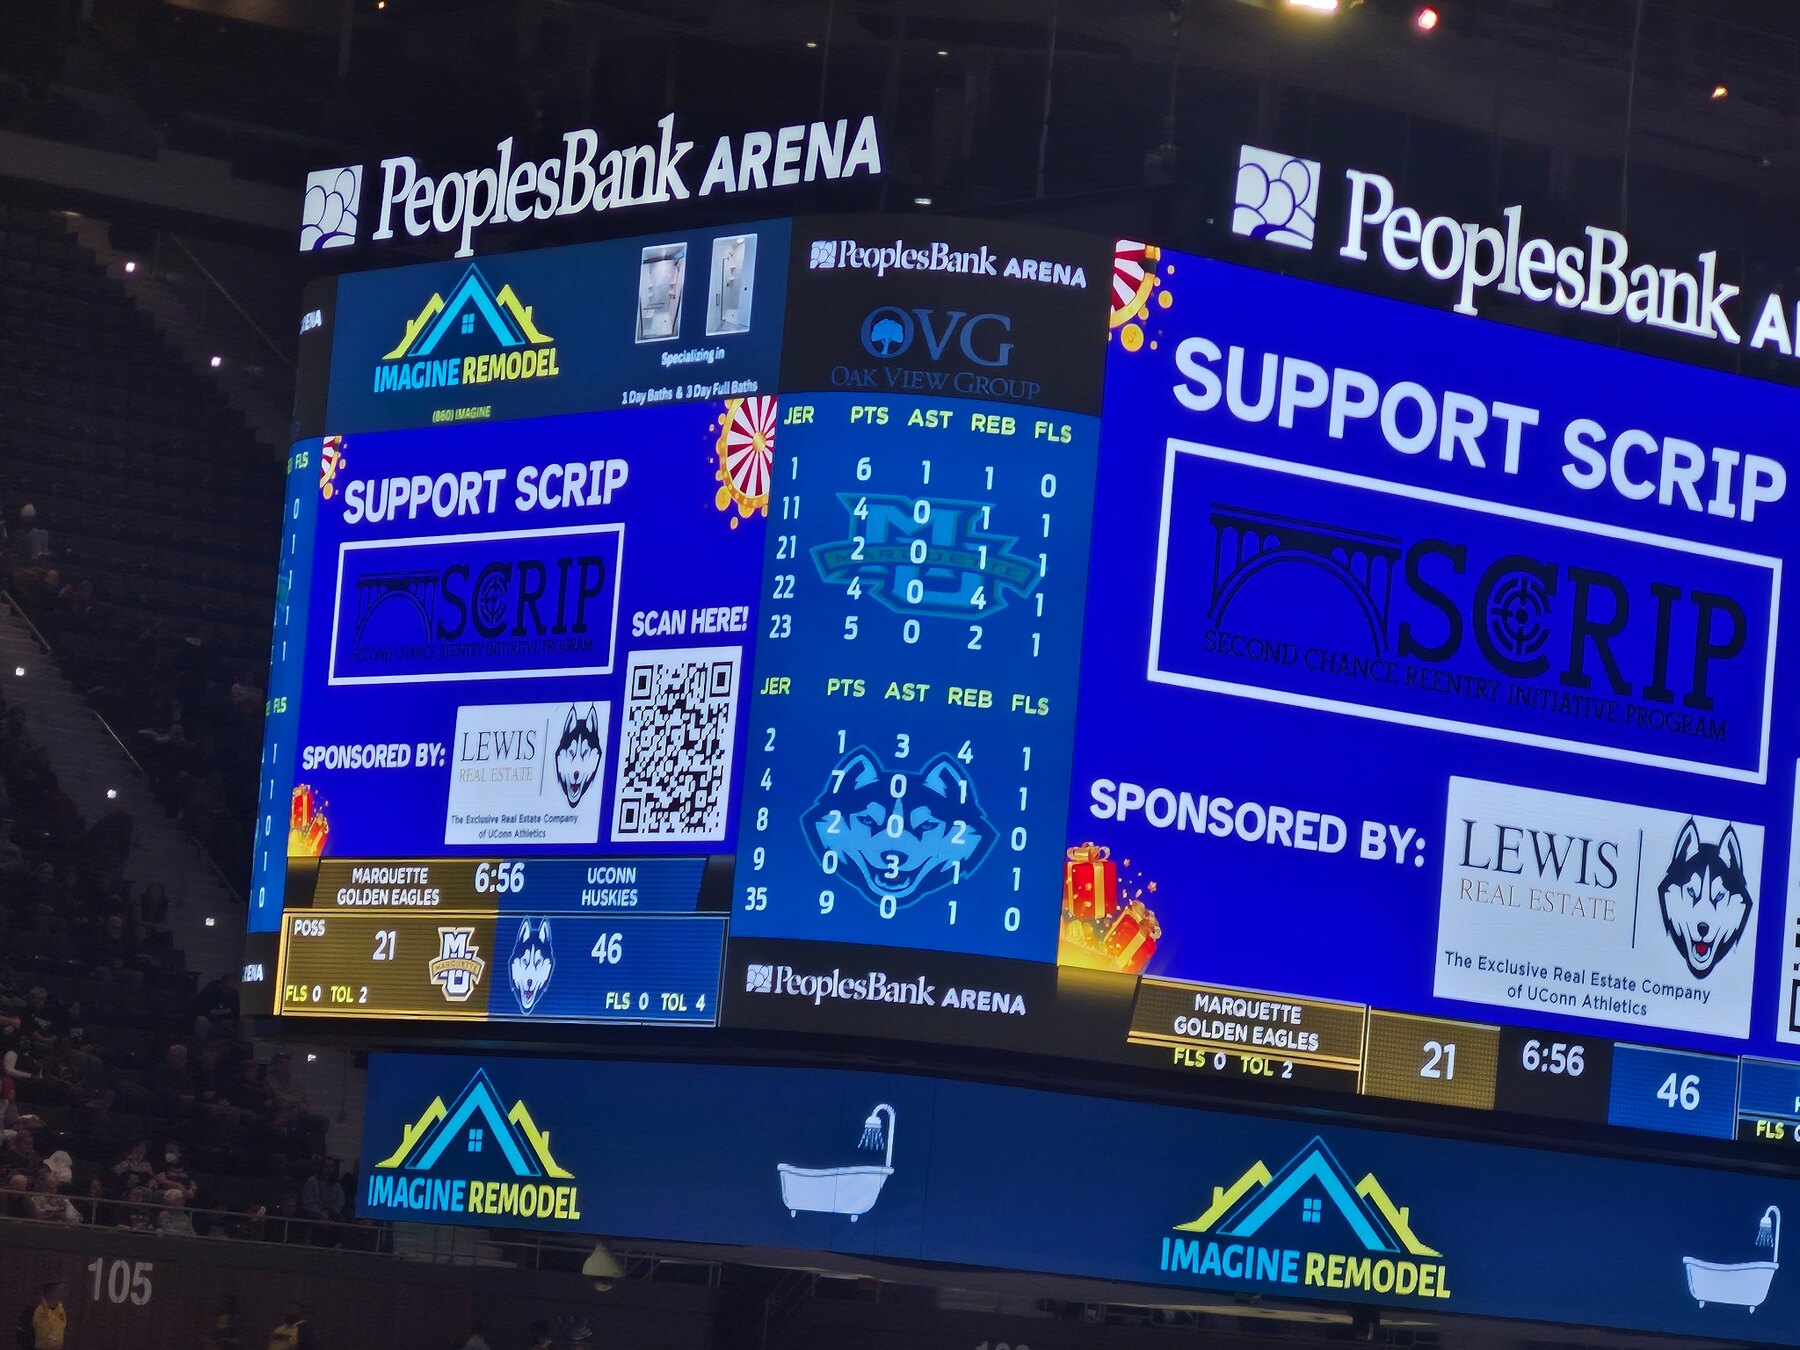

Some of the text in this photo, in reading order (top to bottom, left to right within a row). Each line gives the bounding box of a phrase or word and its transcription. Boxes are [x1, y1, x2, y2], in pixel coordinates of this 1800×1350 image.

[372, 112, 881, 258] PeoplesBank ARENA
[838, 240, 1086, 288] PeoplesBank ARENA
[1340, 169, 1740, 344] PeoplesBank
[861, 306, 1014, 367] OVG
[374, 348, 559, 392] IMAGINE REMODEL
[662, 347, 725, 367] Specializing in
[629, 391, 647, 406] Day
[647, 387, 673, 402] Baths
[676, 386, 683, 399] &
[686, 385, 693, 398] 3
[694, 384, 712, 400] Day
[713, 381, 730, 396] Full
[731, 379, 758, 394] Baths
[831, 366, 1041, 400] OAK VIEW GROUP
[432, 406, 491, 423] (860) IMAGINE
[784, 406, 1071, 443] JER PTS AST REB FLS
[1173, 335, 1786, 522] SUPPORT SCRIP
[343, 459, 628, 524] SUPPORT SCRIP
[792, 457, 1056, 498] 1 6 1 1 0
[783, 496, 1049, 537] 11 4 0 1 1
[777, 535, 796, 559] 21
[851, 536, 864, 560] 2
[911, 539, 927, 563] 0
[979, 546, 986, 569] 1
[1039, 554, 1046, 577] 1
[436, 555, 605, 641] SCRIP
[773, 575, 1043, 617] 22 4 0 4 1
[632, 606, 748, 637] SCAN HERE!
[770, 614, 1040, 657] 23 5 0 2 1
[1399, 538, 1748, 711] SCRIP
[761, 677, 1049, 715] JER PTS AST REB FLS
[1203, 630, 1727, 741] SECOND CHANCE REENTRY INITIATIVE PROGRAM
[303, 743, 445, 770] SPONSORED BY:
[460, 730, 537, 761] LEWIS
[765, 728, 1030, 771] 2 1 3 4 1
[459, 766, 533, 782] REAL ESTATE
[761, 768, 1027, 811] 4 7 0 1
[451, 814, 578, 825] The Exclusive Real Estate Company
[479, 829, 546, 838] of UConn Athletics
[757, 807, 1026, 851] 8 0
[1089, 777, 1425, 867] SPONSORED BY:
[754, 847, 1020, 891] 9 1
[1458, 818, 1618, 889] LEWIS
[352, 868, 428, 884] MARQUETTE
[475, 863, 524, 892] 6:56
[588, 867, 636, 884] UCONN
[337, 888, 439, 905] GOLDEN EAGLES
[582, 889, 637, 906] HUSKIES
[745, 887, 1020, 931] 35 9 0 1 0
[1460, 878, 1616, 921] REAL ESTATE
[294, 919, 325, 936] POSS
[373, 931, 395, 960] 21
[591, 933, 622, 963] 46
[286, 985, 367, 1003] FLS 0 TOL 2
[774, 966, 1025, 1015] PeoplesBank ARENA
[1445, 951, 1711, 1004] The Exclusive Real Estate Company
[606, 992, 705, 1011] FLS 0 TOL 4
[1194, 993, 1302, 1025] MARQUETTE
[1507, 984, 1647, 1016] of UConn Athletics
[1173, 1016, 1318, 1051] GOLDEN EAGLES
[1173, 1047, 1293, 1079] FLS 0 TOL 2
[1421, 1041, 1455, 1079] 21
[1523, 1040, 1584, 1076] 6:56
[1657, 1073, 1699, 1110] 46
[1757, 1119, 1784, 1139] FLS
[368, 1175, 580, 1219] IMAGINE REMODEL
[88, 1258, 153, 1305] 105
[1161, 1238, 1450, 1298] IMAGINE REMODEL
